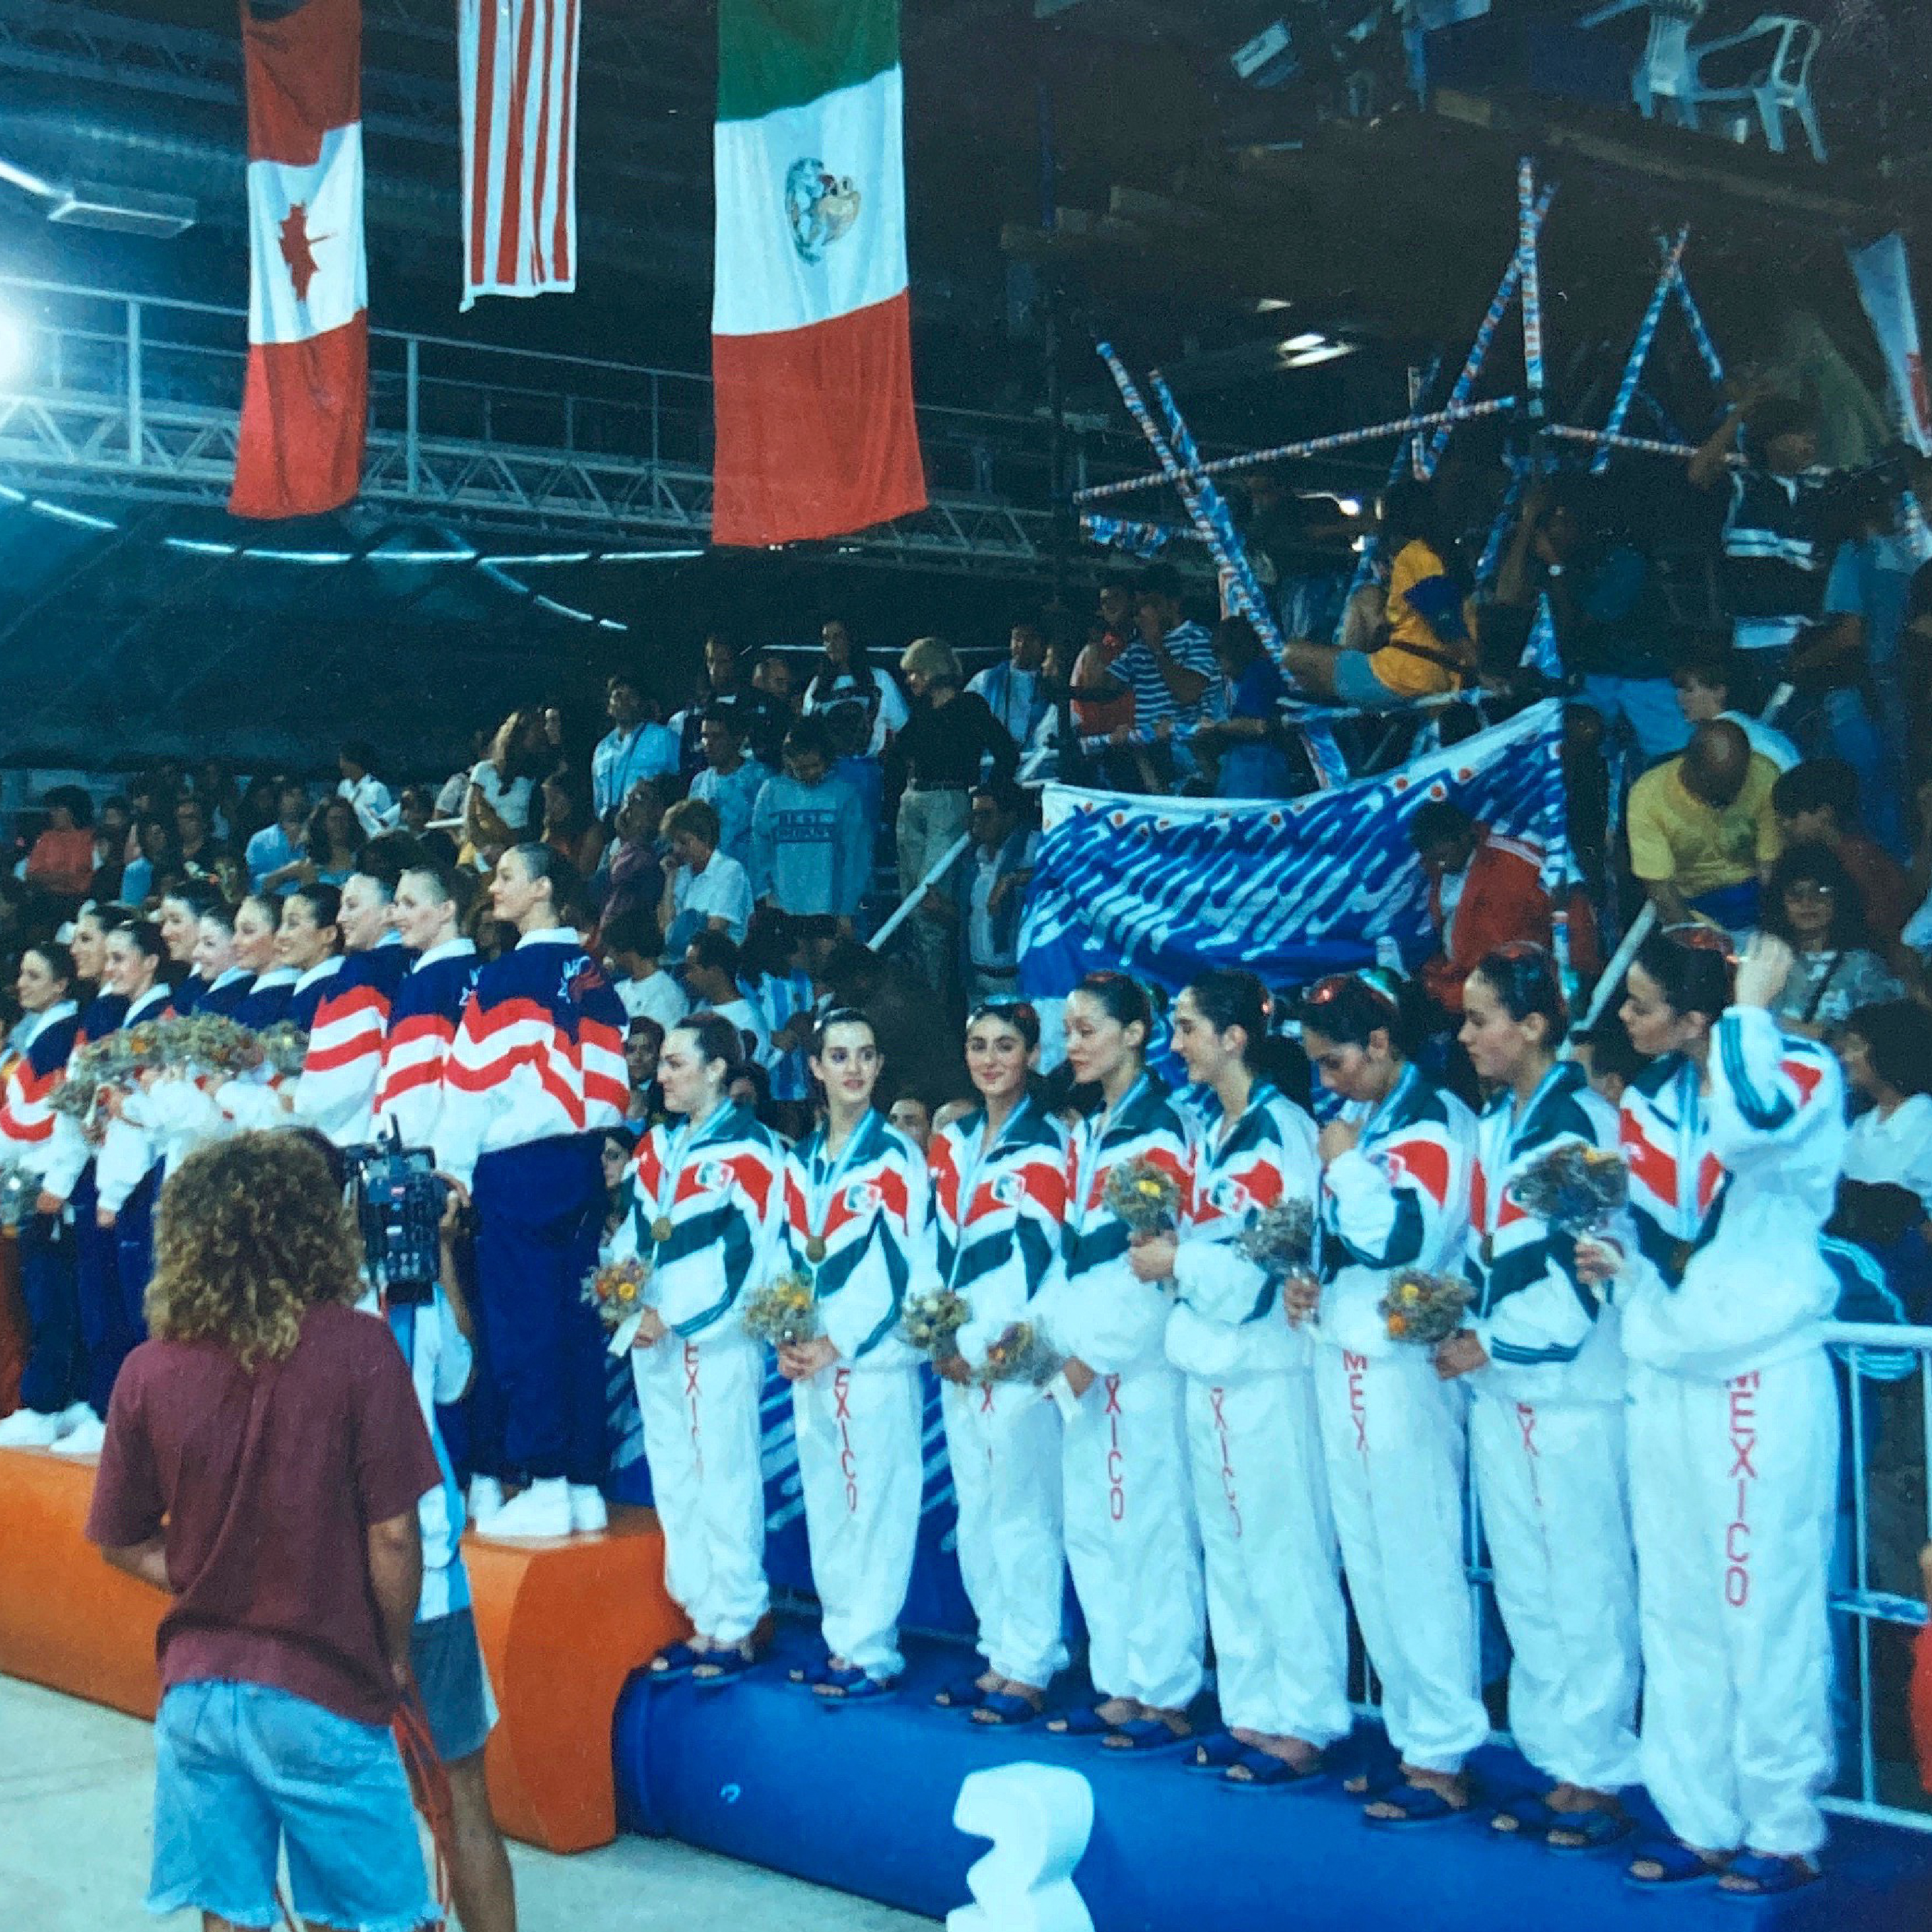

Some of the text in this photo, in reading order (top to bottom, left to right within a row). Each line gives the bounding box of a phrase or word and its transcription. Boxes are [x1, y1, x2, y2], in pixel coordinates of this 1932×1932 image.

[834, 1368, 859, 1511] EXICO
[1105, 1373, 1124, 1522] XICO
[1725, 1369, 1760, 1607] MEXICO
